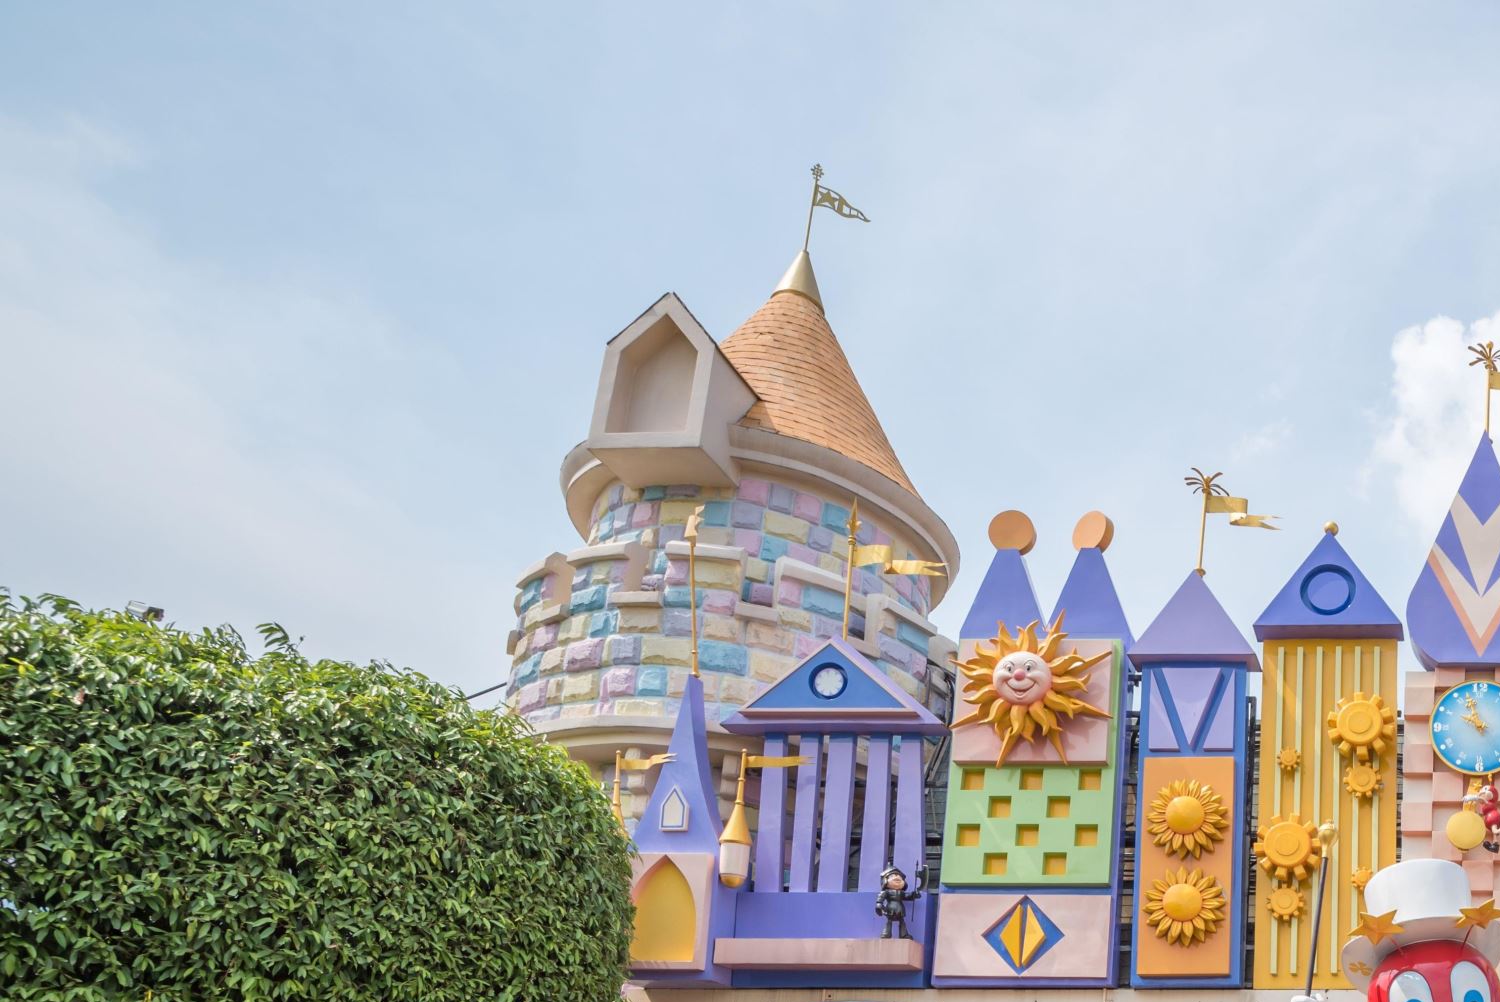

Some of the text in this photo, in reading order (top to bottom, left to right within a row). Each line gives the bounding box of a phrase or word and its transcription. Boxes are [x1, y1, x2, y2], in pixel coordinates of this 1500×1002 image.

[1472, 683, 1488, 693] 12
[1433, 722, 1441, 732] 9
[1475, 762, 1484, 772] 6
